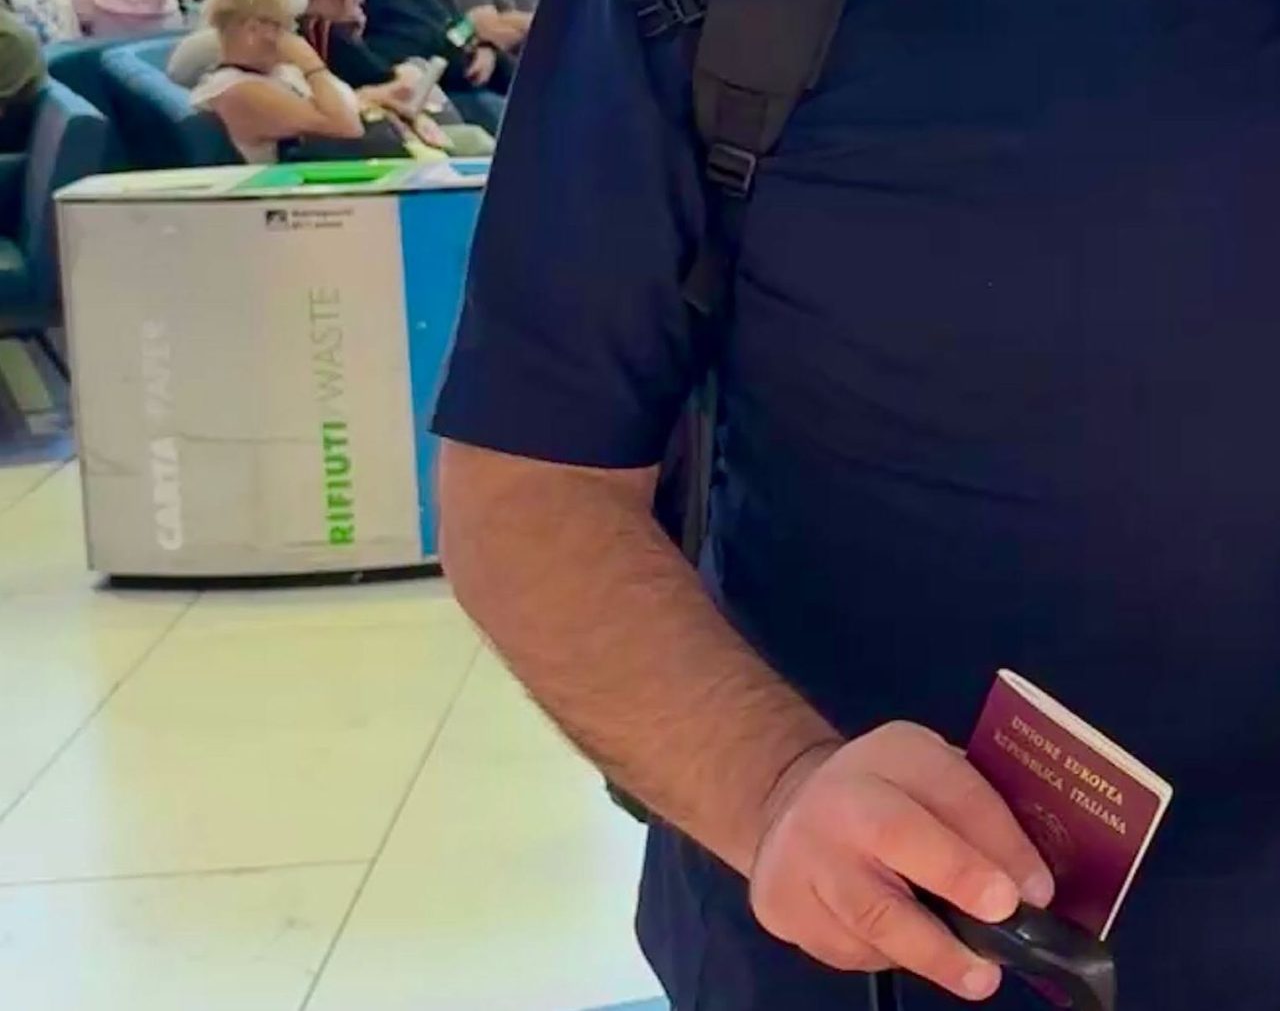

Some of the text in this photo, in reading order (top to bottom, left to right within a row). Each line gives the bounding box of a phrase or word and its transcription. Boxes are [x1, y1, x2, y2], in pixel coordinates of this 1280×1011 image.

[309, 286, 355, 545] RIFIUTI WASTE
[1011, 715, 1122, 806] UNIONE EUROPEA
[1069, 787, 1128, 835] ITALIANA
